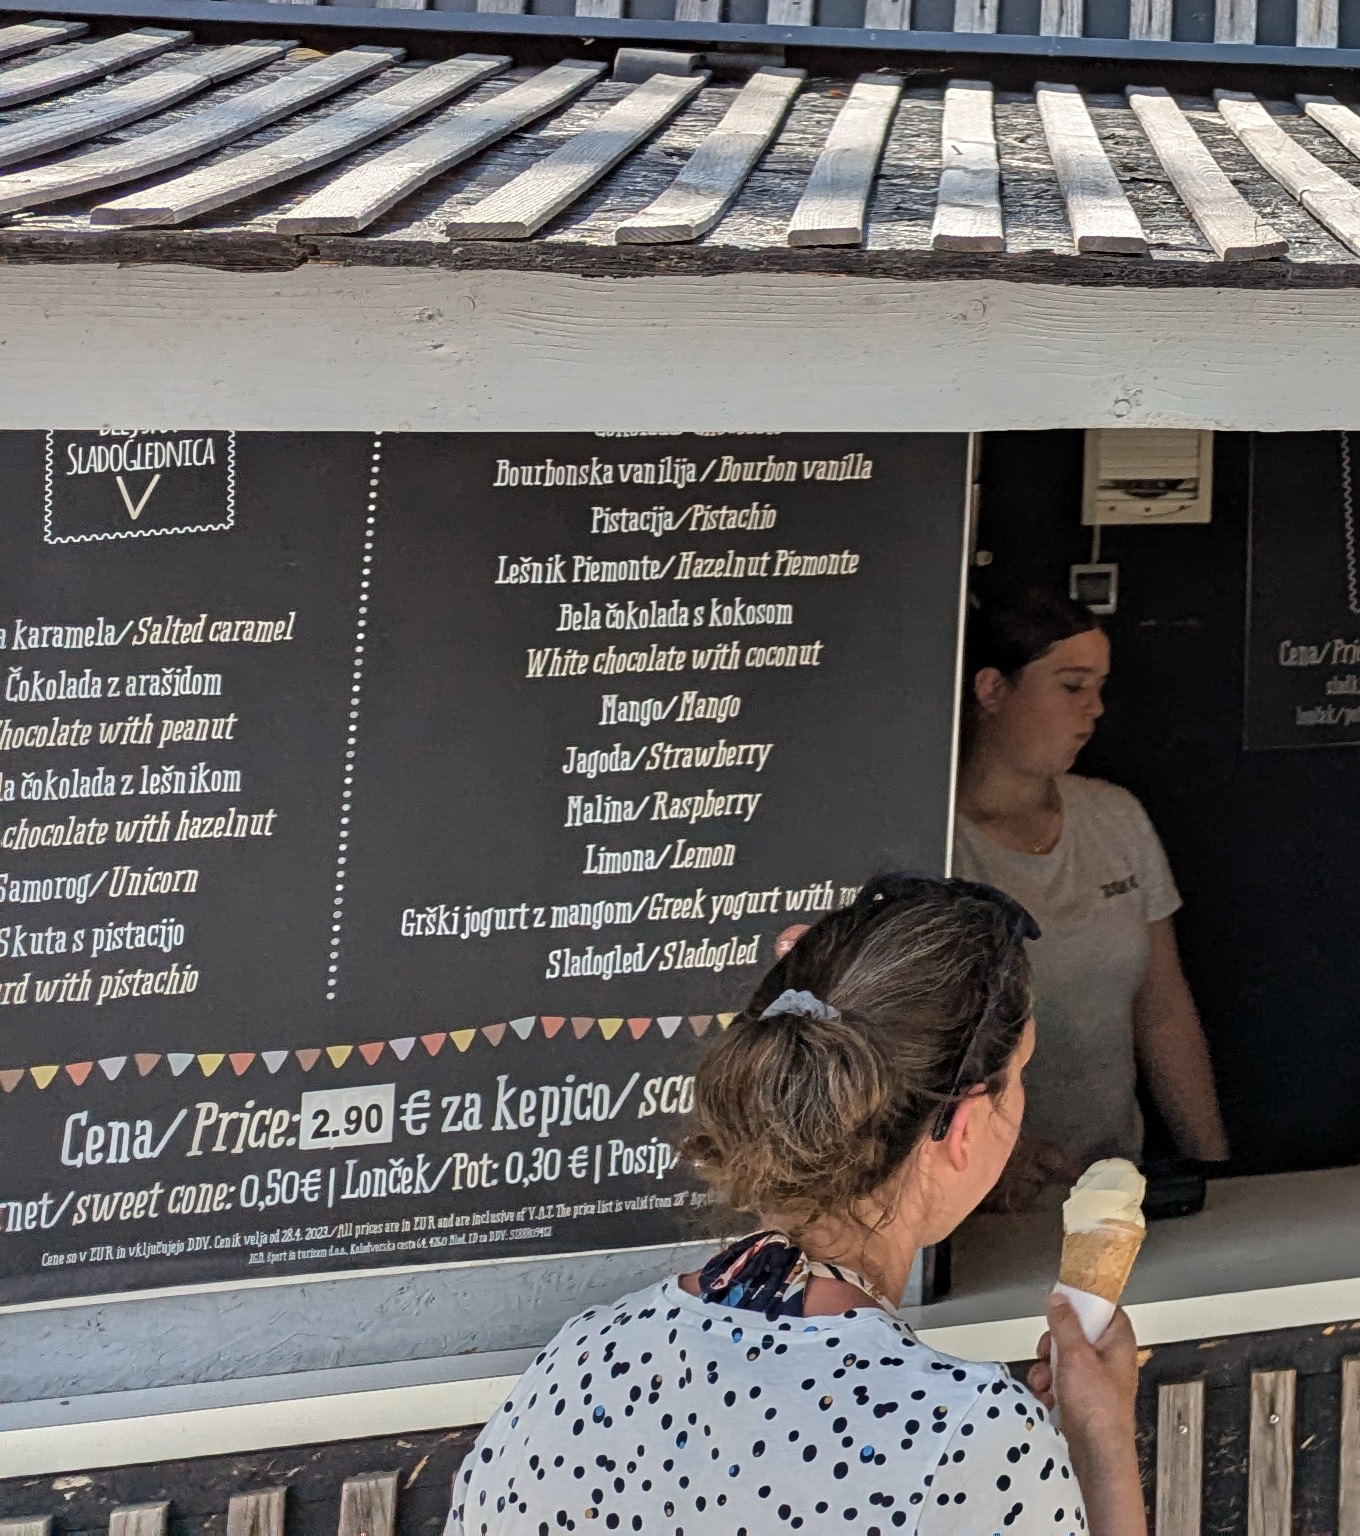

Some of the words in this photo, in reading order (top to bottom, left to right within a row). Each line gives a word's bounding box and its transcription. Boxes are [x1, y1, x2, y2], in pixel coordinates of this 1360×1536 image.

[66, 438, 214, 475] SLADOGLEDNICA
[493, 457, 614, 486] Bourbonska
[618, 456, 697, 489] vanilija
[714, 456, 796, 483] Bourbon
[803, 453, 872, 481] vanilla
[495, 554, 566, 584] Lešnik
[773, 550, 859, 576] Piemonte
[209, 612, 296, 642] caramel
[556, 603, 601, 631] Bela
[606, 599, 689, 629] čokolada
[693, 606, 704, 627] s
[708, 597, 792, 627] kokosom
[526, 648, 589, 678] White
[593, 644, 686, 674] chocolate
[692, 641, 740, 670] with
[745, 640, 824, 667] coconut
[6, 667, 102, 702] Čokolada
[107, 677, 120, 697] z
[126, 665, 221, 696] arašidom
[0, 717, 92, 750] hocolate
[99, 713, 153, 744] with
[157, 713, 238, 748] peanut
[21, 767, 115, 800] čokolada
[121, 775, 134, 795] z
[139, 762, 241, 794] lešnikom
[3, 816, 108, 850] chocolate
[116, 811, 170, 843] with
[174, 807, 277, 841] hazelnut
[400, 903, 459, 938] Grški
[460, 902, 530, 941] jogurt
[532, 907, 547, 929] z
[708, 886, 782, 925] yogurt
[785, 879, 833, 911] with
[0, 925, 67, 957] Skuta
[72, 929, 85, 953] s
[91, 918, 184, 957] pistacijo
[36, 969, 92, 1002] with
[96, 963, 198, 1005] pistachio
[311, 1103, 383, 1138] 2.90
[400, 1090, 430, 1135] €
[441, 1093, 482, 1132] za
[168, 1183, 236, 1214] cone:
[505, 1147, 561, 1187] 0,30
[568, 1146, 588, 1178] €
[41, 1252, 65, 1267] Cene
[65, 1252, 77, 1265] so
[79, 1251, 88, 1262] v
[89, 1245, 113, 1262] EUR
[115, 1246, 126, 1260] in
[214, 1233, 242, 1249] Cenik
[243, 1231, 268, 1247] velja
[269, 1230, 280, 1243] od
[354, 1220, 383, 1239] prices
[384, 1219, 400, 1233] are
[401, 1219, 411, 1232] in
[413, 1215, 436, 1232] EUR
[437, 1213, 454, 1228] and
[455, 1215, 470, 1227] are
[471, 1210, 514, 1227] inclusive
[516, 1207, 528, 1221] of
[556, 1203, 571, 1218] The
[573, 1203, 596, 1219] price
[597, 1199, 613, 1214] list
[614, 1200, 623, 1213] is
[624, 1195, 649, 1211] valid
[649, 1194, 672, 1210] from
